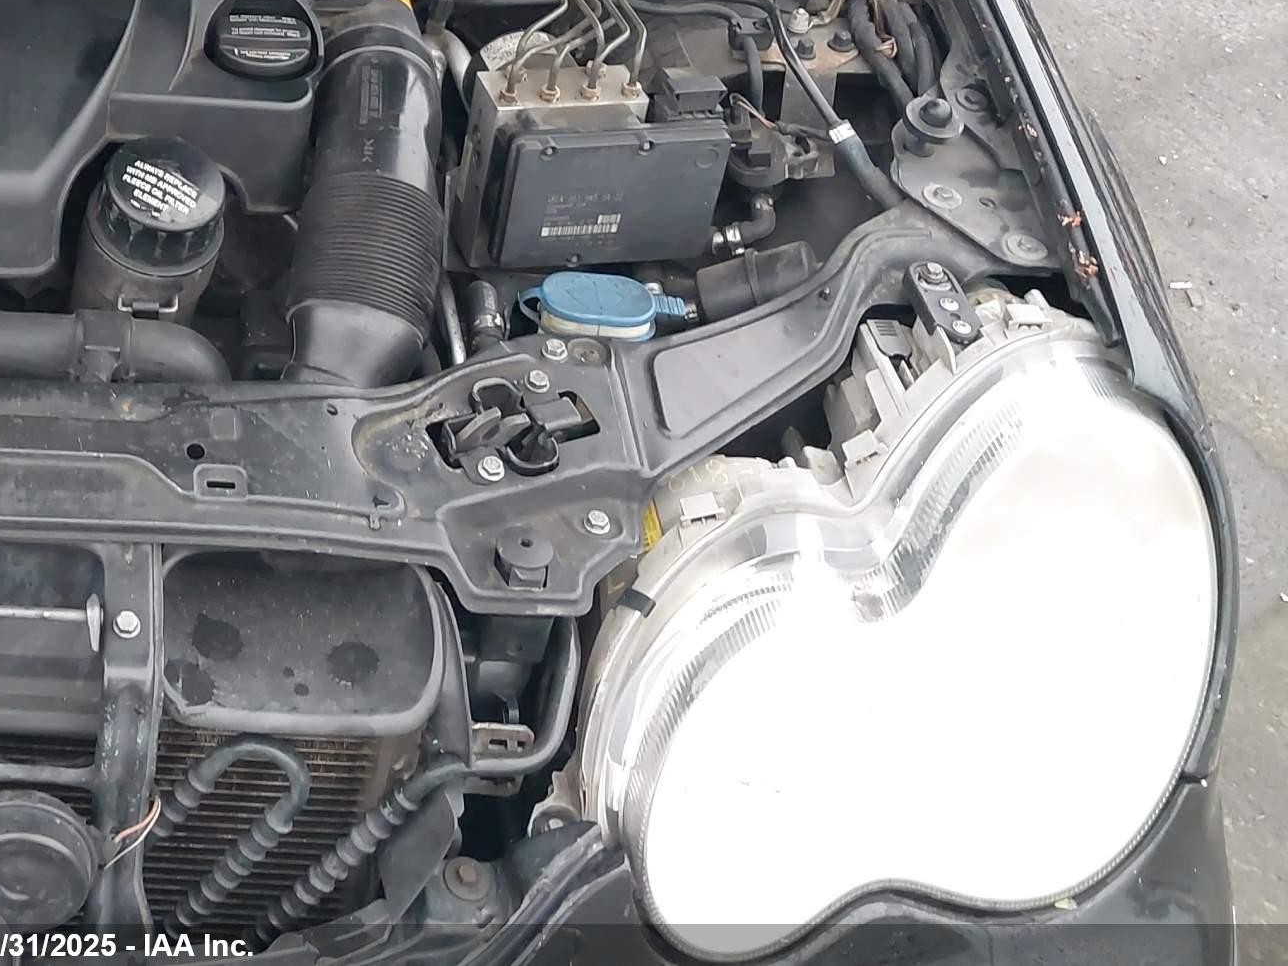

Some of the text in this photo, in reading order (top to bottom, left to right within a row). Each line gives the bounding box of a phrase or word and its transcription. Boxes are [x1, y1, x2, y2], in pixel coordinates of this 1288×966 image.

[122, 173, 152, 194] FLEECE
[164, 194, 190, 215] FILTER
[126, 165, 145, 180] WITH
[157, 180, 197, 209] APPROVED
[134, 160, 198, 199] ALWAYS REPLACE
[133, 188, 169, 212] ELEMENT
